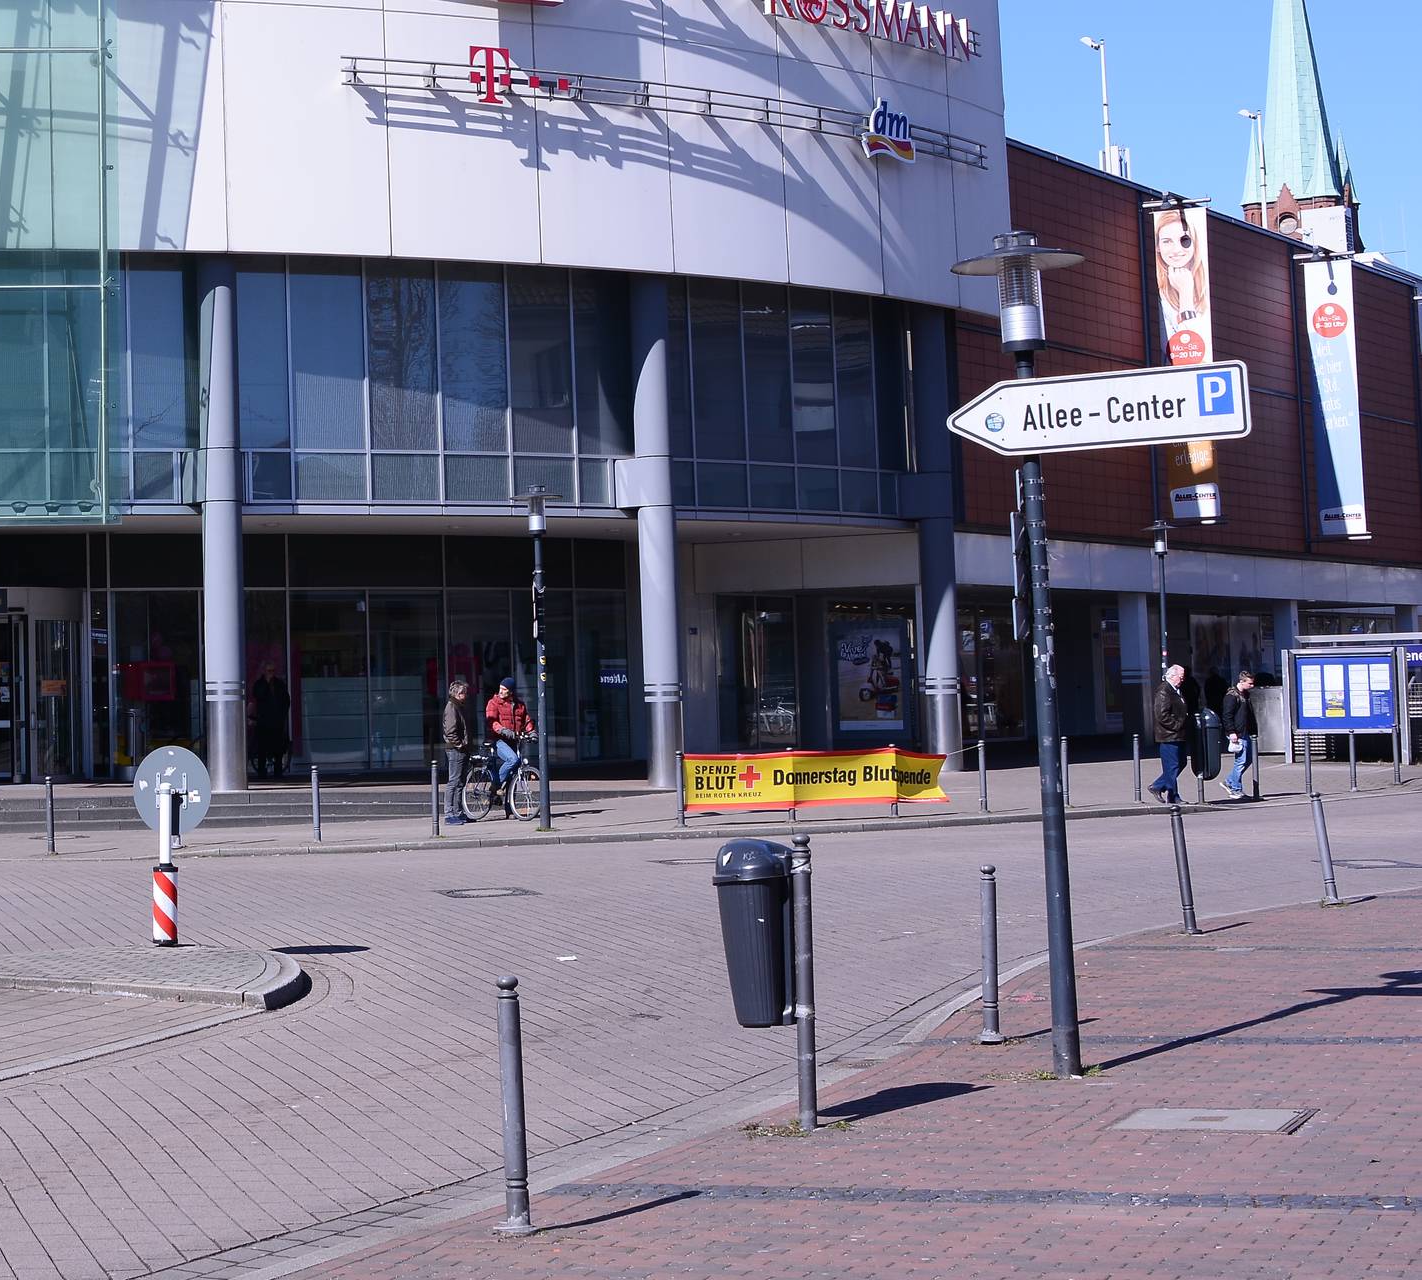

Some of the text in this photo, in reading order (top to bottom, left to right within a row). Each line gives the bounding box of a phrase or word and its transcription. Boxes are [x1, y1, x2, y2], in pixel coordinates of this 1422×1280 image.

[872, 100, 909, 140] dm
[1202, 376, 1227, 412] P
[695, 765, 737, 775] SPENDE
[773, 766, 931, 787] Donnerstag Blutpende
[695, 776, 737, 790] BLUT
